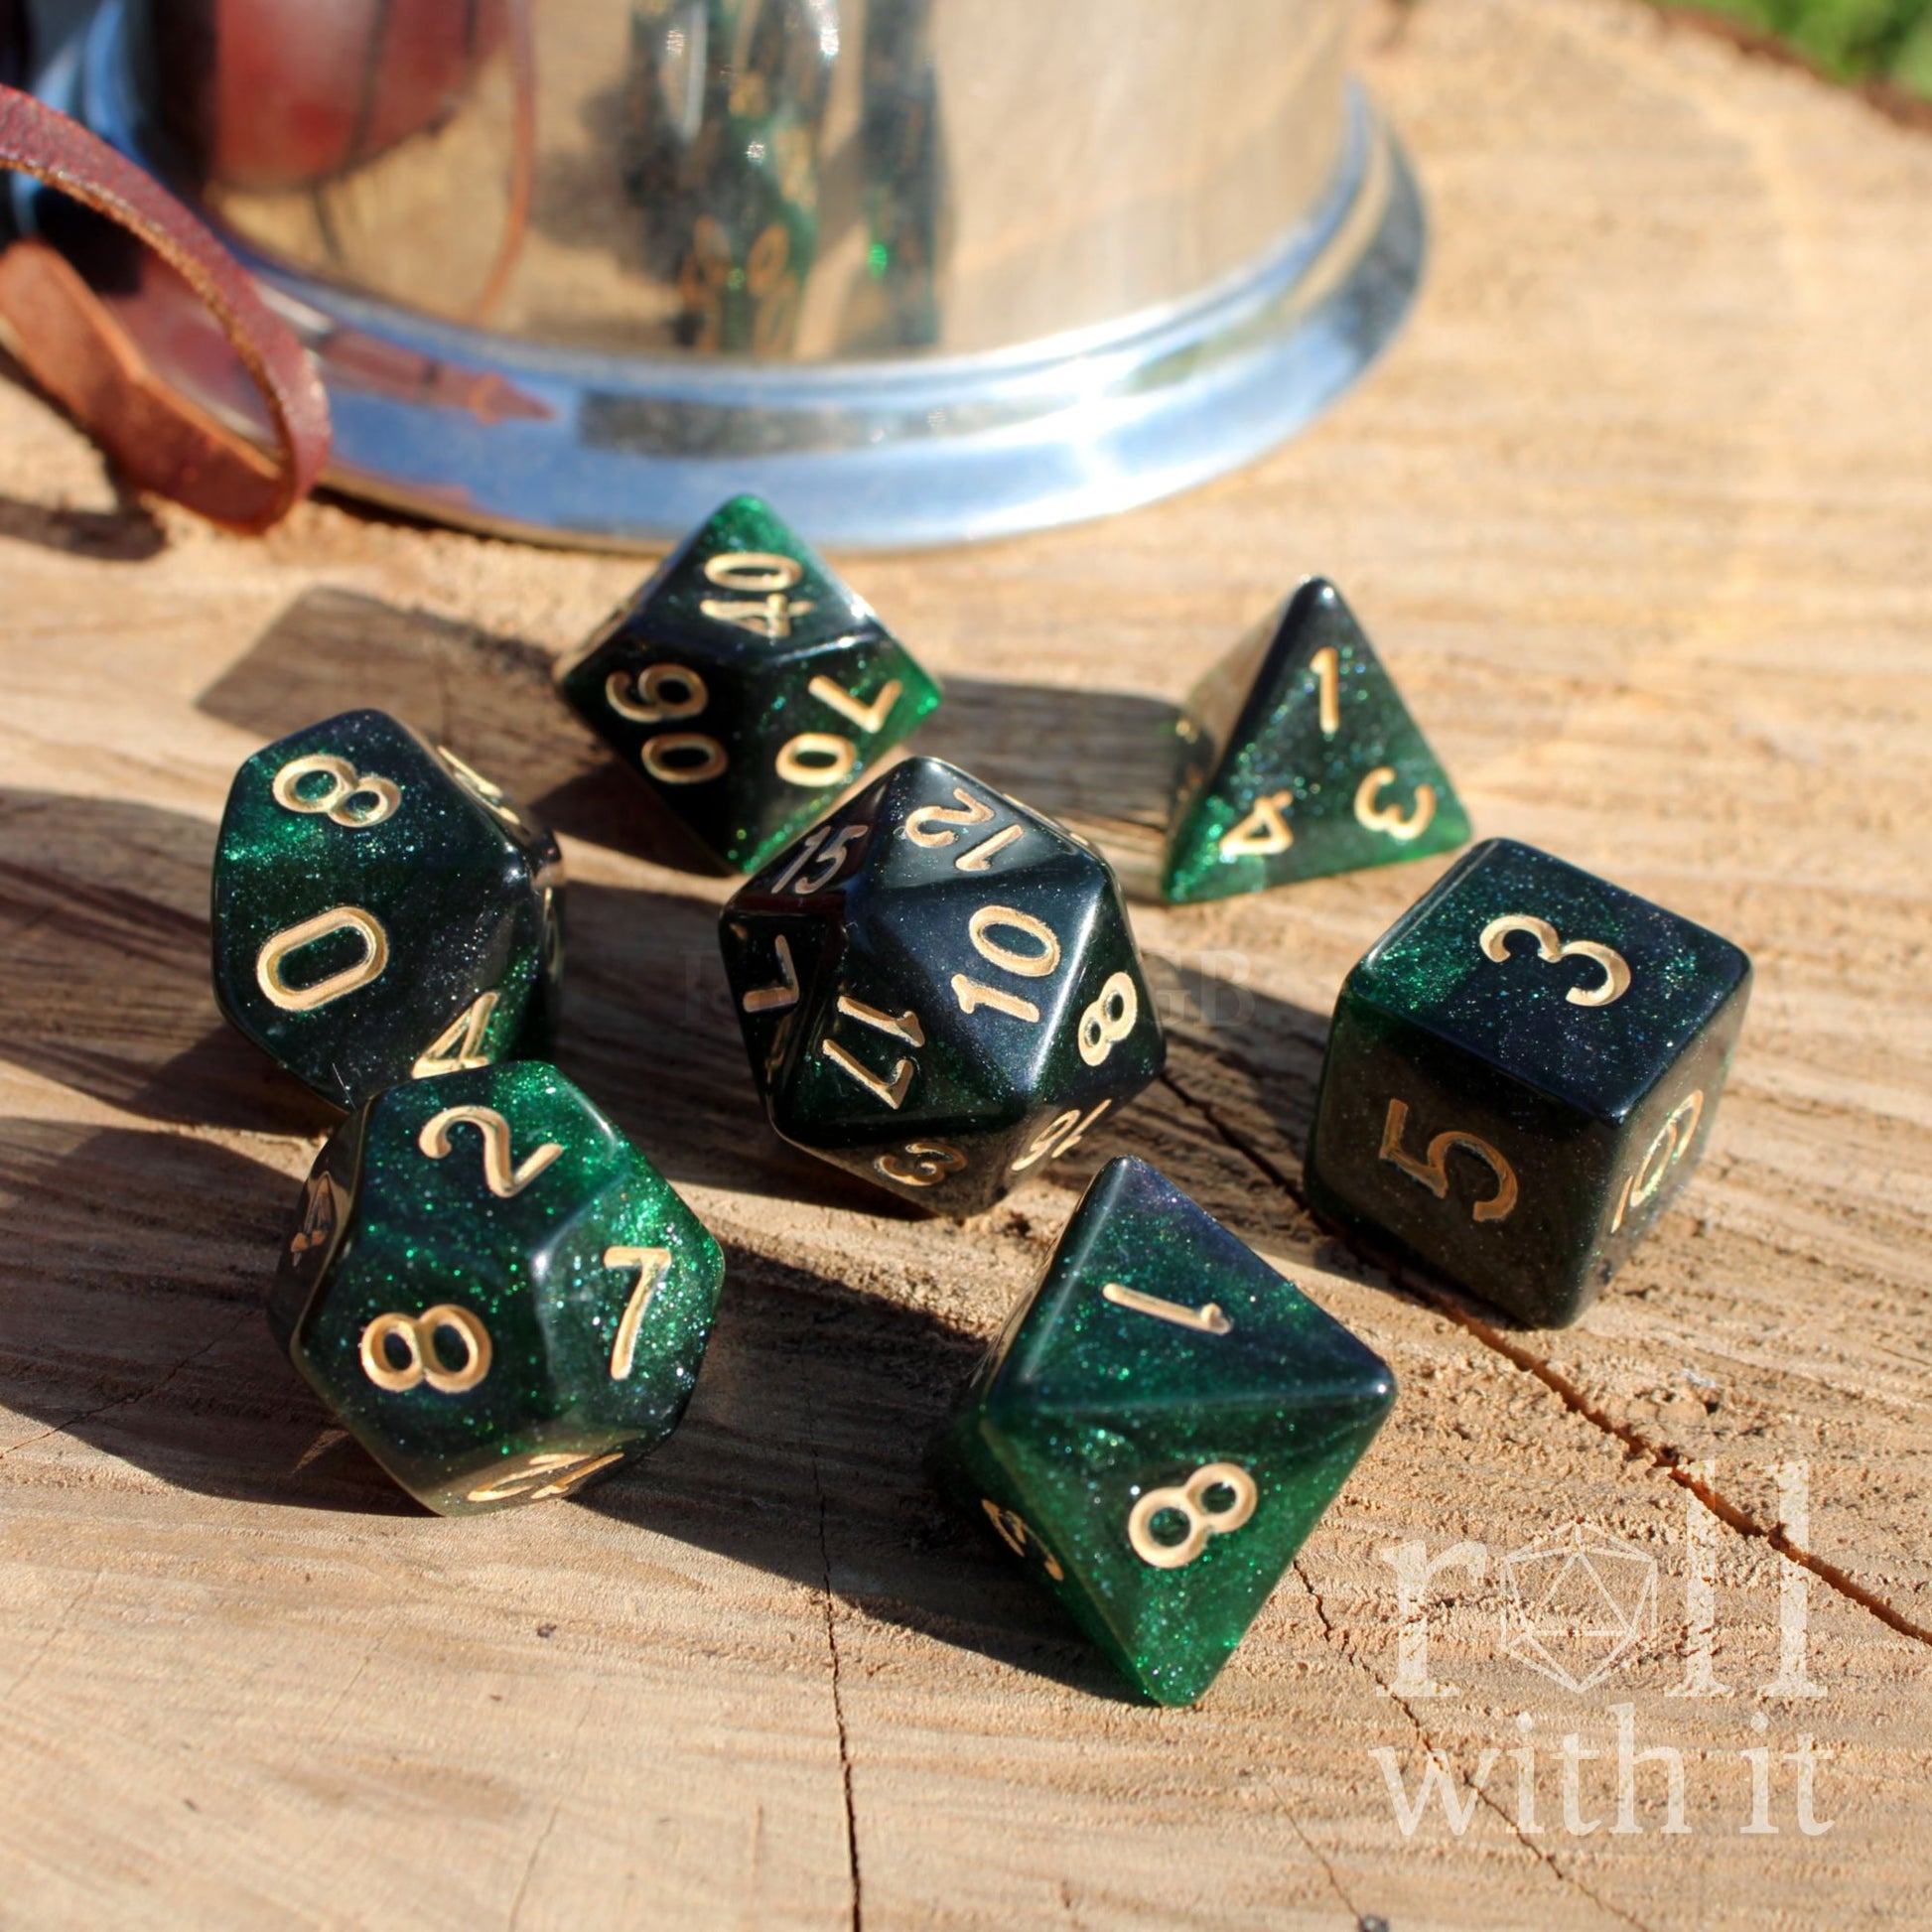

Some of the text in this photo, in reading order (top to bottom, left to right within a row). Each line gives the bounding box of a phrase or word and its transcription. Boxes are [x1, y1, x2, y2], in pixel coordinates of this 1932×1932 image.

[700, 552, 814, 638] 40
[606, 663, 729, 783] 90
[775, 675, 903, 786] 70
[1310, 647, 1338, 734] 1
[272, 754, 401, 828] 8
[905, 787, 1024, 872] 12
[1218, 791, 1293, 859] 4
[1354, 767, 1436, 841] 3
[770, 825, 869, 895] 15
[256, 905, 390, 1011] 0
[951, 904, 1060, 1023] 10
[1479, 914, 1631, 1007] 3
[823, 995, 924, 1109] 17
[1078, 971, 1137, 1066] 8
[419, 1105, 564, 1198] 2
[874, 1142, 967, 1185] 3
[1379, 1098, 1519, 1223] 5
[360, 1304, 492, 1394] 8
[604, 1246, 671, 1380] 7
[1103, 1283, 1234, 1335] 1
[1129, 1462, 1258, 1569] 8
